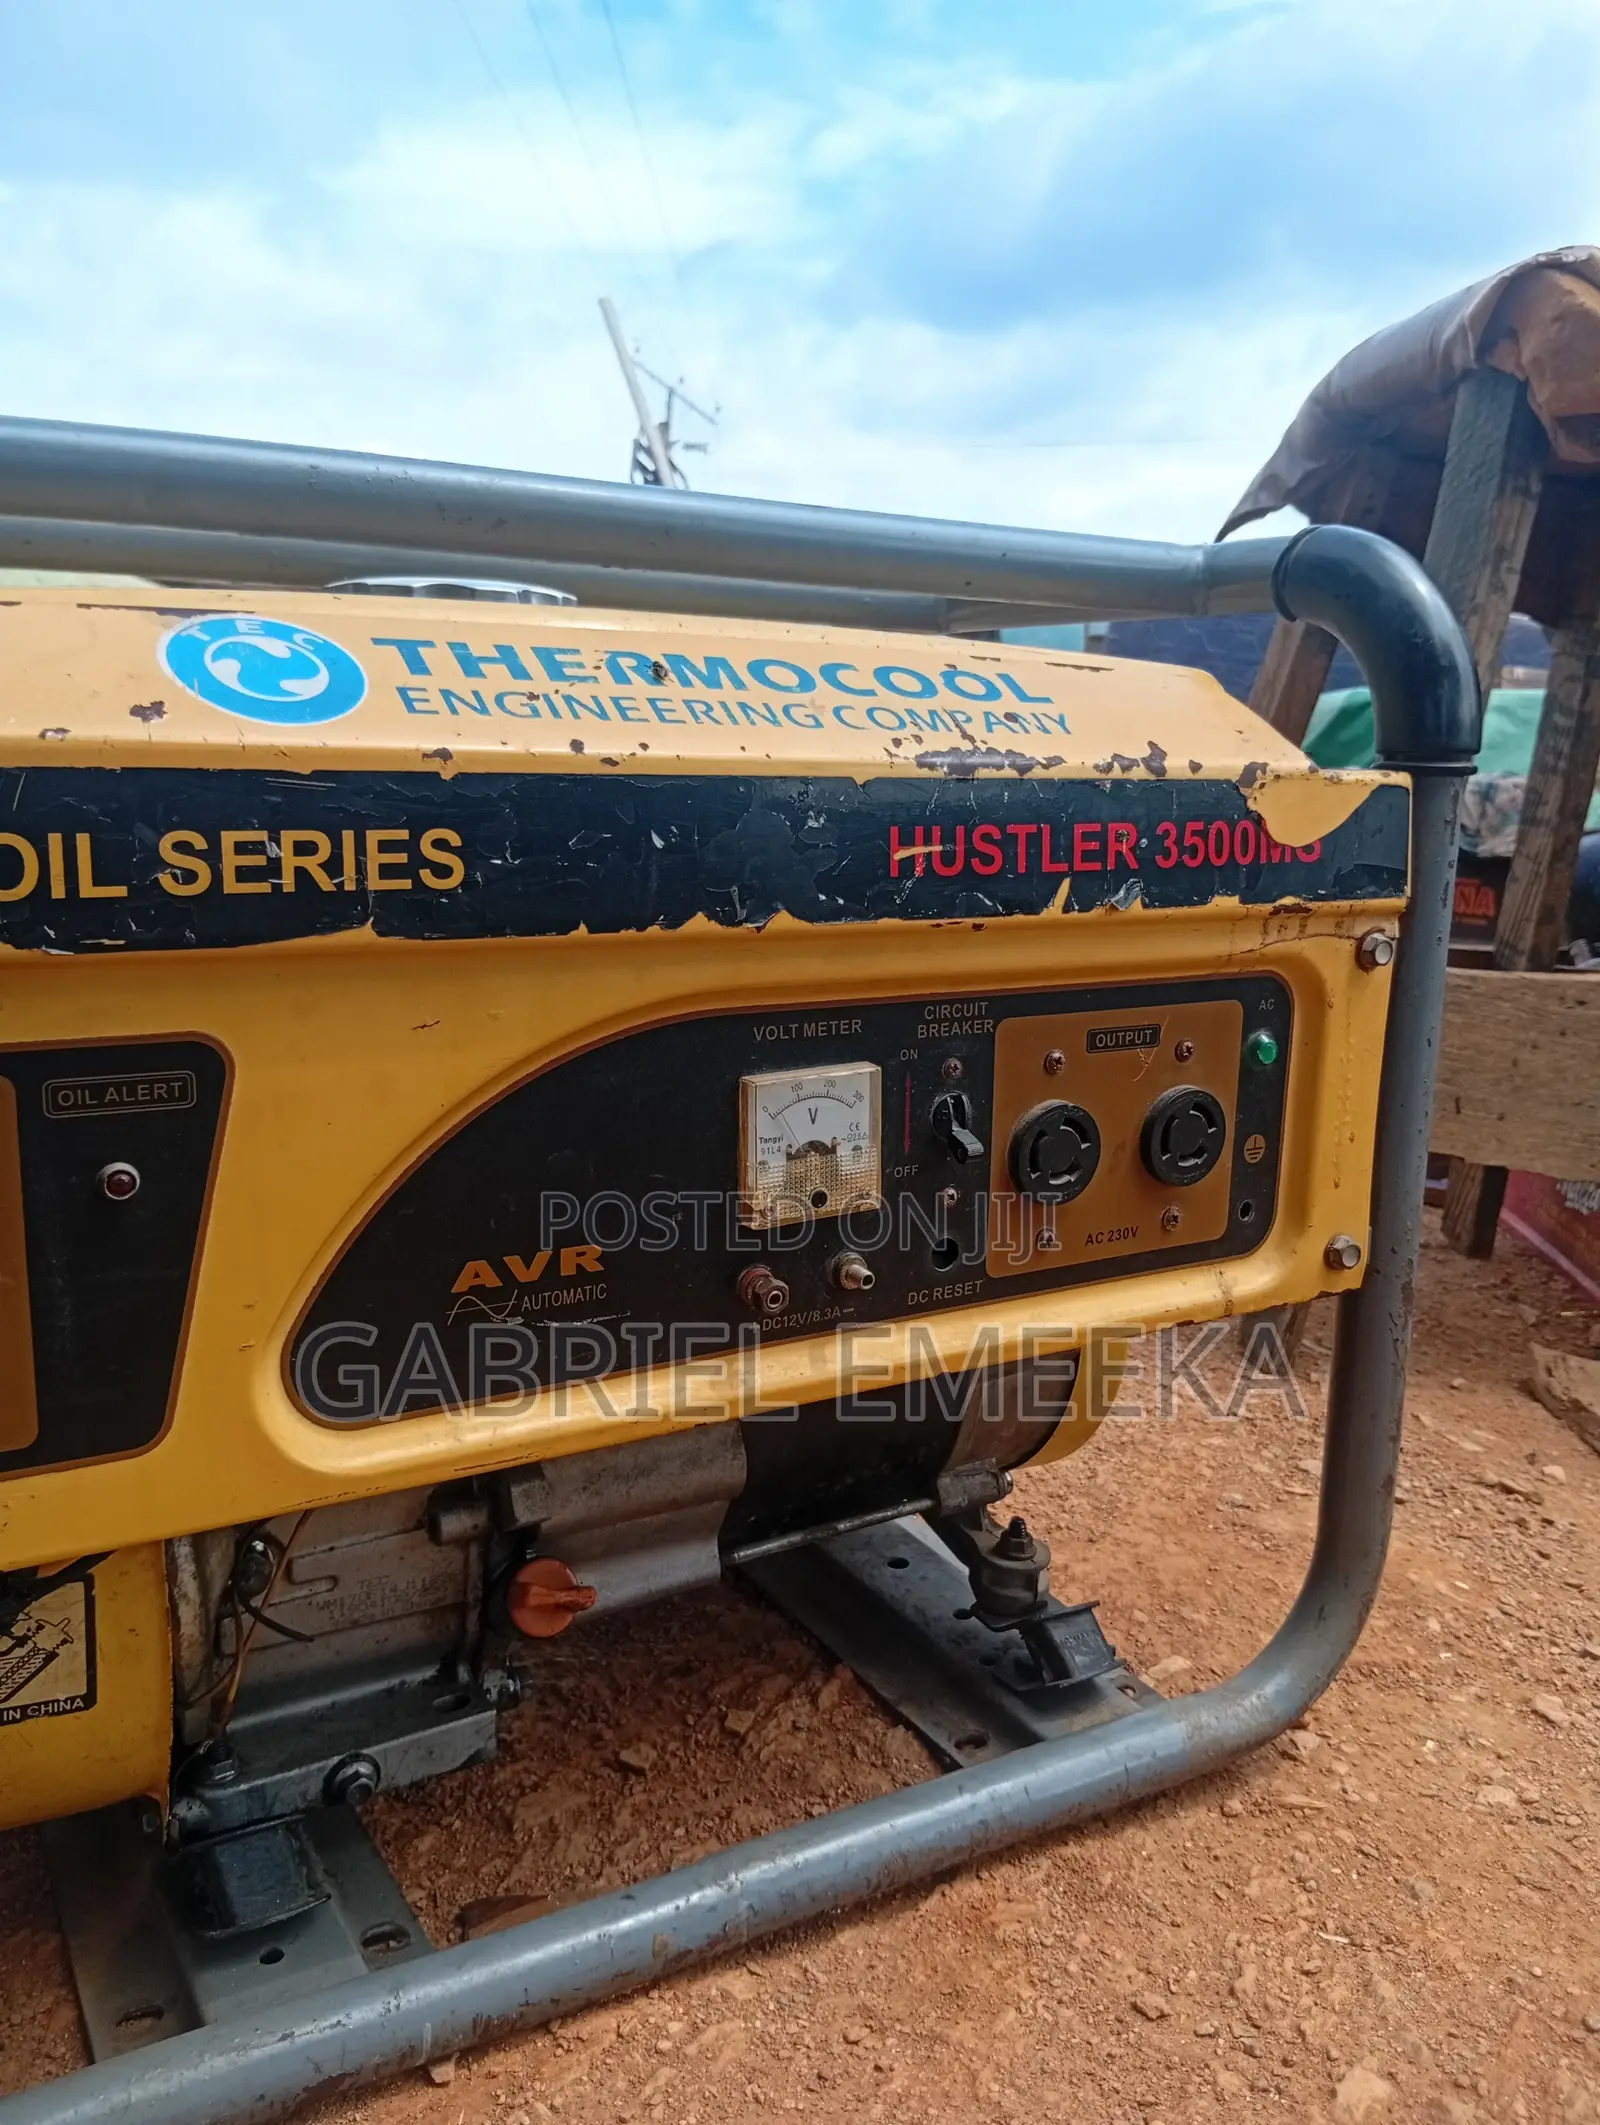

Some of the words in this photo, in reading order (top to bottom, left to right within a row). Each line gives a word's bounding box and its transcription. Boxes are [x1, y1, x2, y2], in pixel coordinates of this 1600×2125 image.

[370, 637, 1056, 705] THERMOCOOL
[395, 686, 825, 730] ENGINEERING
[832, 704, 1074, 736] COMPANY
[889, 822, 1140, 878] HUSTLER
[158, 828, 466, 897] SERIES
[923, 1001, 990, 1021] CIRCUIT
[1258, 998, 1275, 1011] AC
[753, 1022, 799, 1042] VOLT
[803, 1018, 863, 1038] METER
[917, 1019, 994, 1039] BREAKER
[1095, 1029, 1153, 1049] OUTPUT
[900, 1048, 919, 1061] ON
[57, 1088, 98, 1107] OIL
[104, 1081, 184, 1103] ALERT
[791, 1082, 803, 1093] 100
[824, 1080, 836, 1088] 200
[853, 1091, 864, 1102] 300
[808, 1108, 818, 1125] V
[894, 1164, 919, 1179] OFF
[1084, 1231, 1105, 1247] AC
[1107, 1225, 1140, 1243] 230V
[450, 1244, 605, 1293] AVR
[520, 1283, 608, 1313] AUTOMATIC
[907, 1288, 930, 1305] DC
[932, 1279, 984, 1301] RESET
[3, 1707, 21, 1722] IN
[26, 1697, 85, 1717] CHINA
